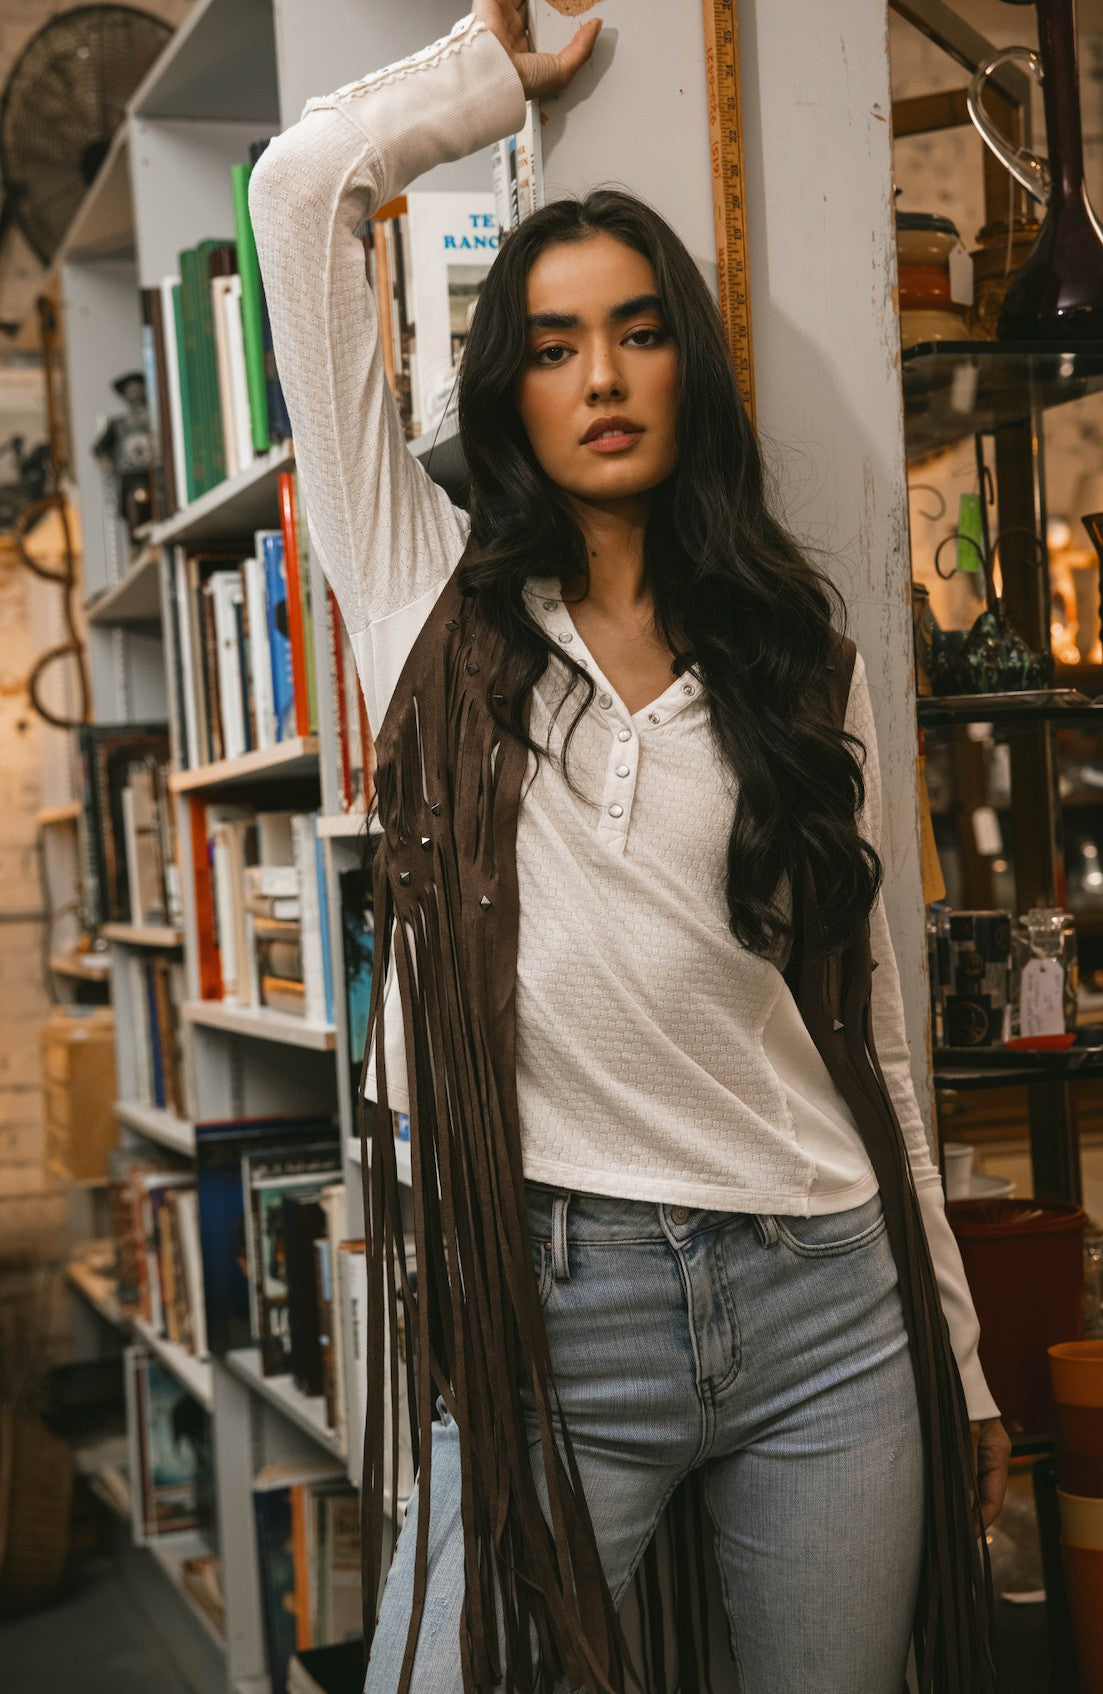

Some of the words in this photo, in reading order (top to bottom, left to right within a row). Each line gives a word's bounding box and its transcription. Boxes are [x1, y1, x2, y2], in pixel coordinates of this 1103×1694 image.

[724, 30, 732, 44] 25
[726, 64, 733, 77] 24
[727, 97, 735, 110] 23
[729, 130, 737, 144] 22
[712, 141, 721, 179] (615)
[731, 164, 739, 177] 21
[732, 195, 740, 209] 20
[734, 228, 742, 240] 19
[736, 260, 743, 272] 18
[718, 246, 729, 338] ISTRIBUTOR
[736, 291, 745, 305] 17
[739, 325, 747, 338] 16
[741, 358, 748, 371] 15
